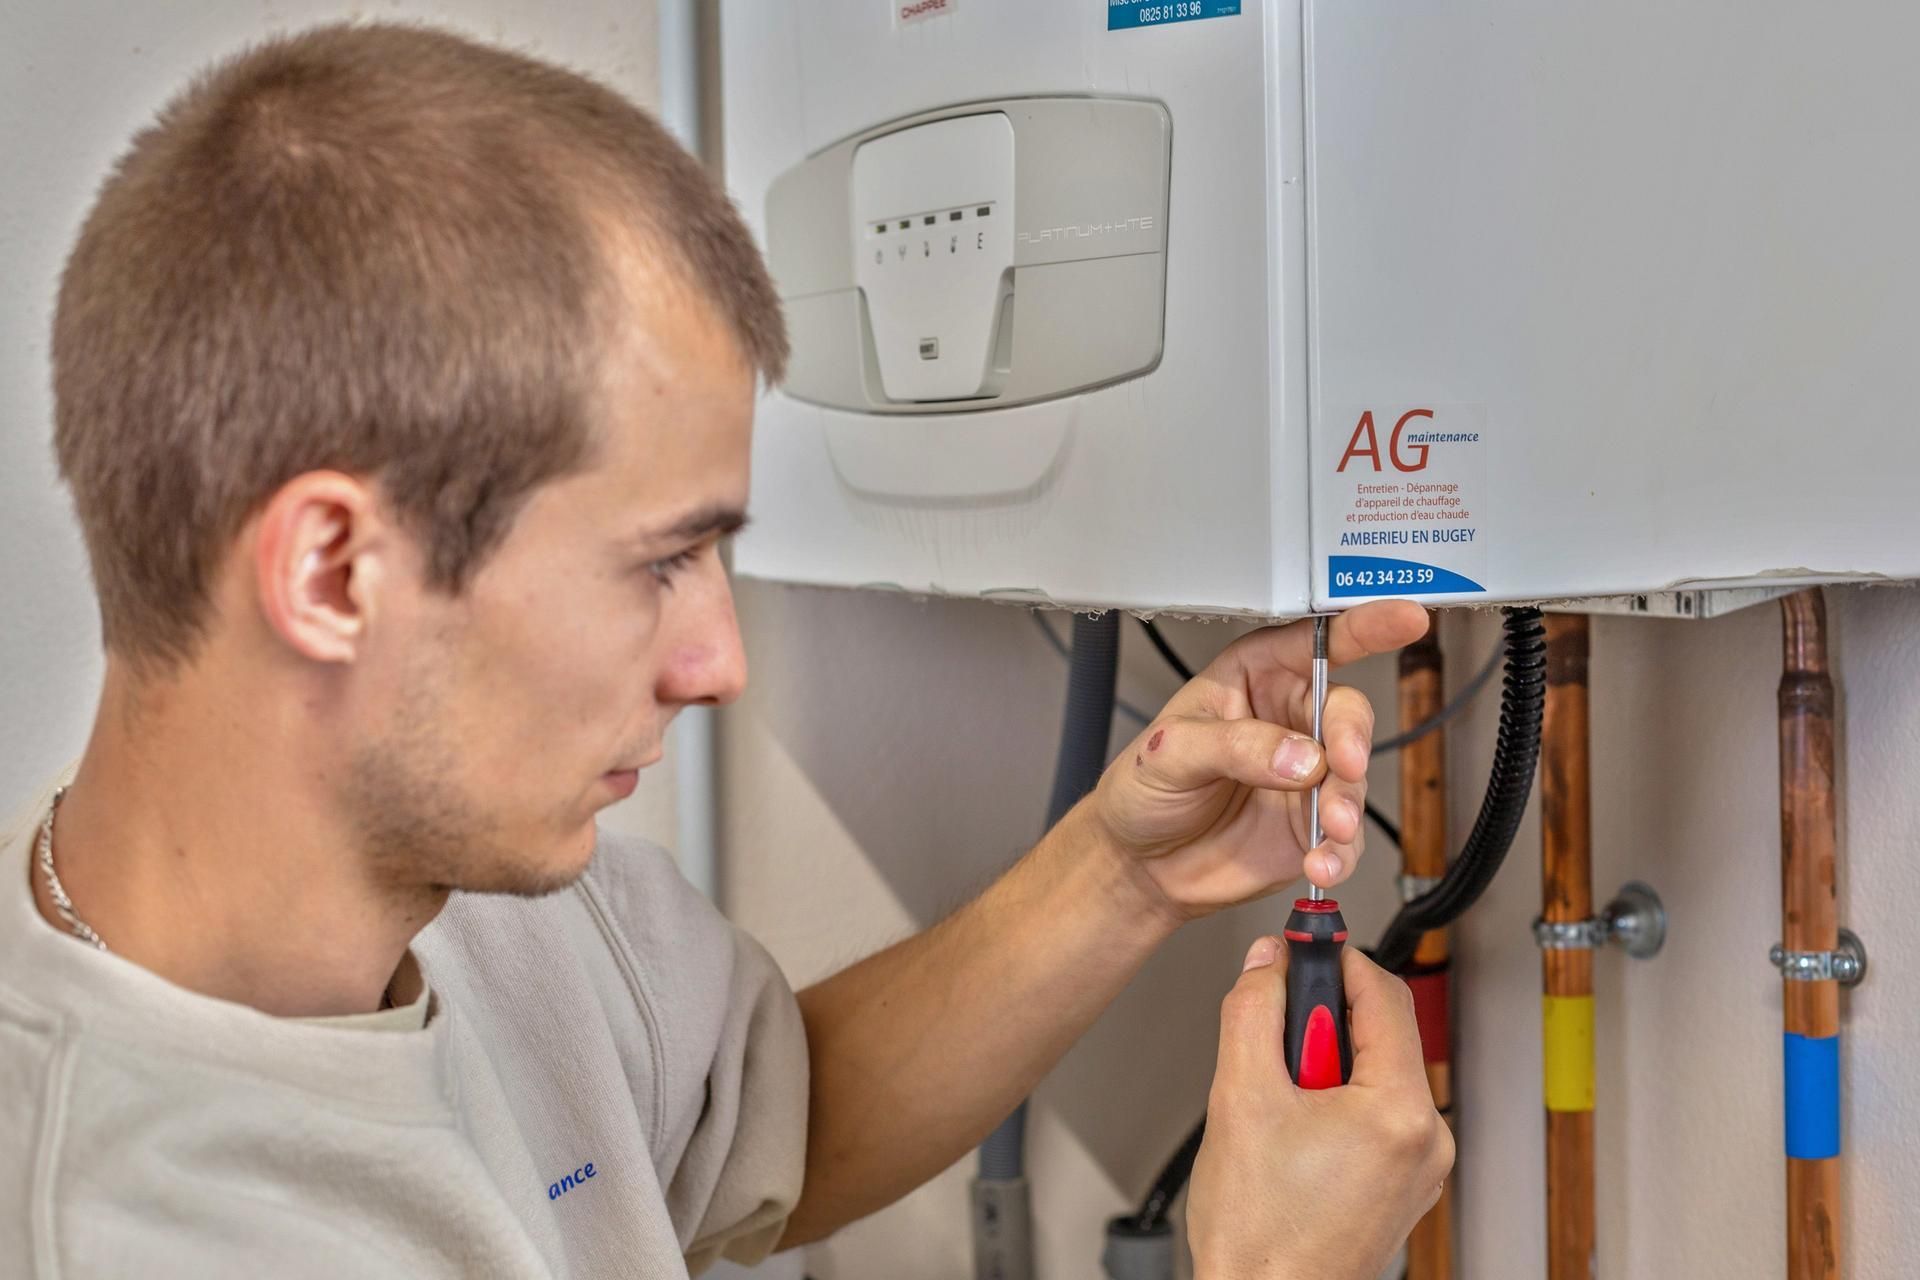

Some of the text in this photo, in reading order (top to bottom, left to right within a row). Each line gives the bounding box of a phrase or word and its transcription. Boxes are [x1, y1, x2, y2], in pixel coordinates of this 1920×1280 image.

[1139, 6, 1161, 23] 0825
[1163, 4, 1173, 19] 81
[1176, 2, 1188, 17] 33
[1190, 1, 1201, 16] 96
[1336, 409, 1434, 472] AG
[1407, 432, 1479, 443] maintenance
[1357, 484, 1399, 495] Entretien
[1406, 482, 1459, 495] Dépannage
[1355, 495, 1461, 509] d'appareil de chauffage
[1346, 513, 1356, 522] et
[1358, 511, 1409, 524] production
[1436, 509, 1469, 520] chaude
[1340, 528, 1476, 546] AMBERIEU EN BUGEY
[1336, 569, 1434, 587] 06 42 34 23 59
